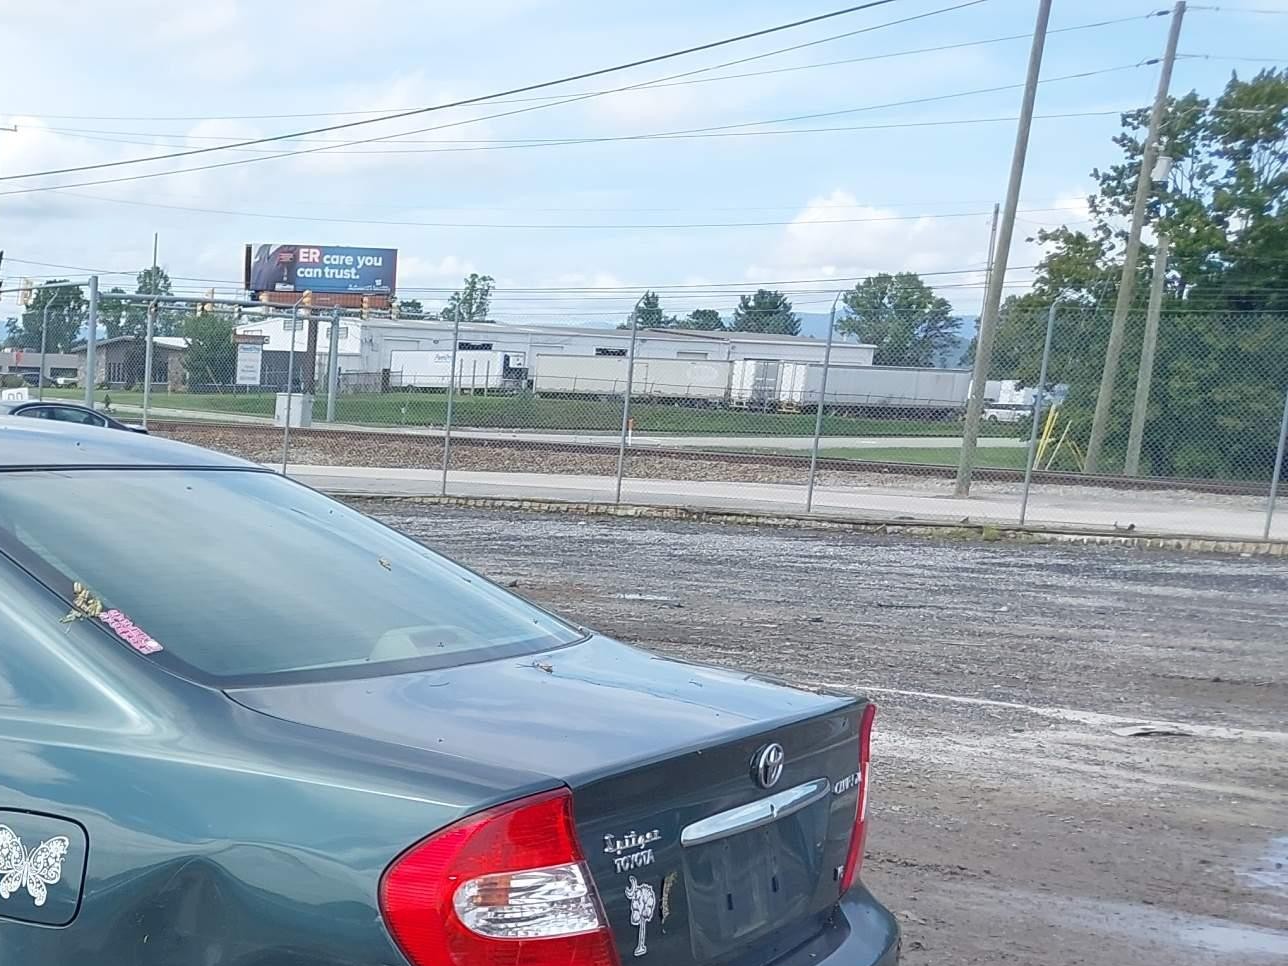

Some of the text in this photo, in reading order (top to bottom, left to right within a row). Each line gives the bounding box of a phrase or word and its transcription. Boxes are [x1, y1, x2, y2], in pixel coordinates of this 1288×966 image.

[298, 248, 383, 269] ER care you
[296, 266, 360, 279] can trust.
[614, 848, 655, 874] TOYOTA
